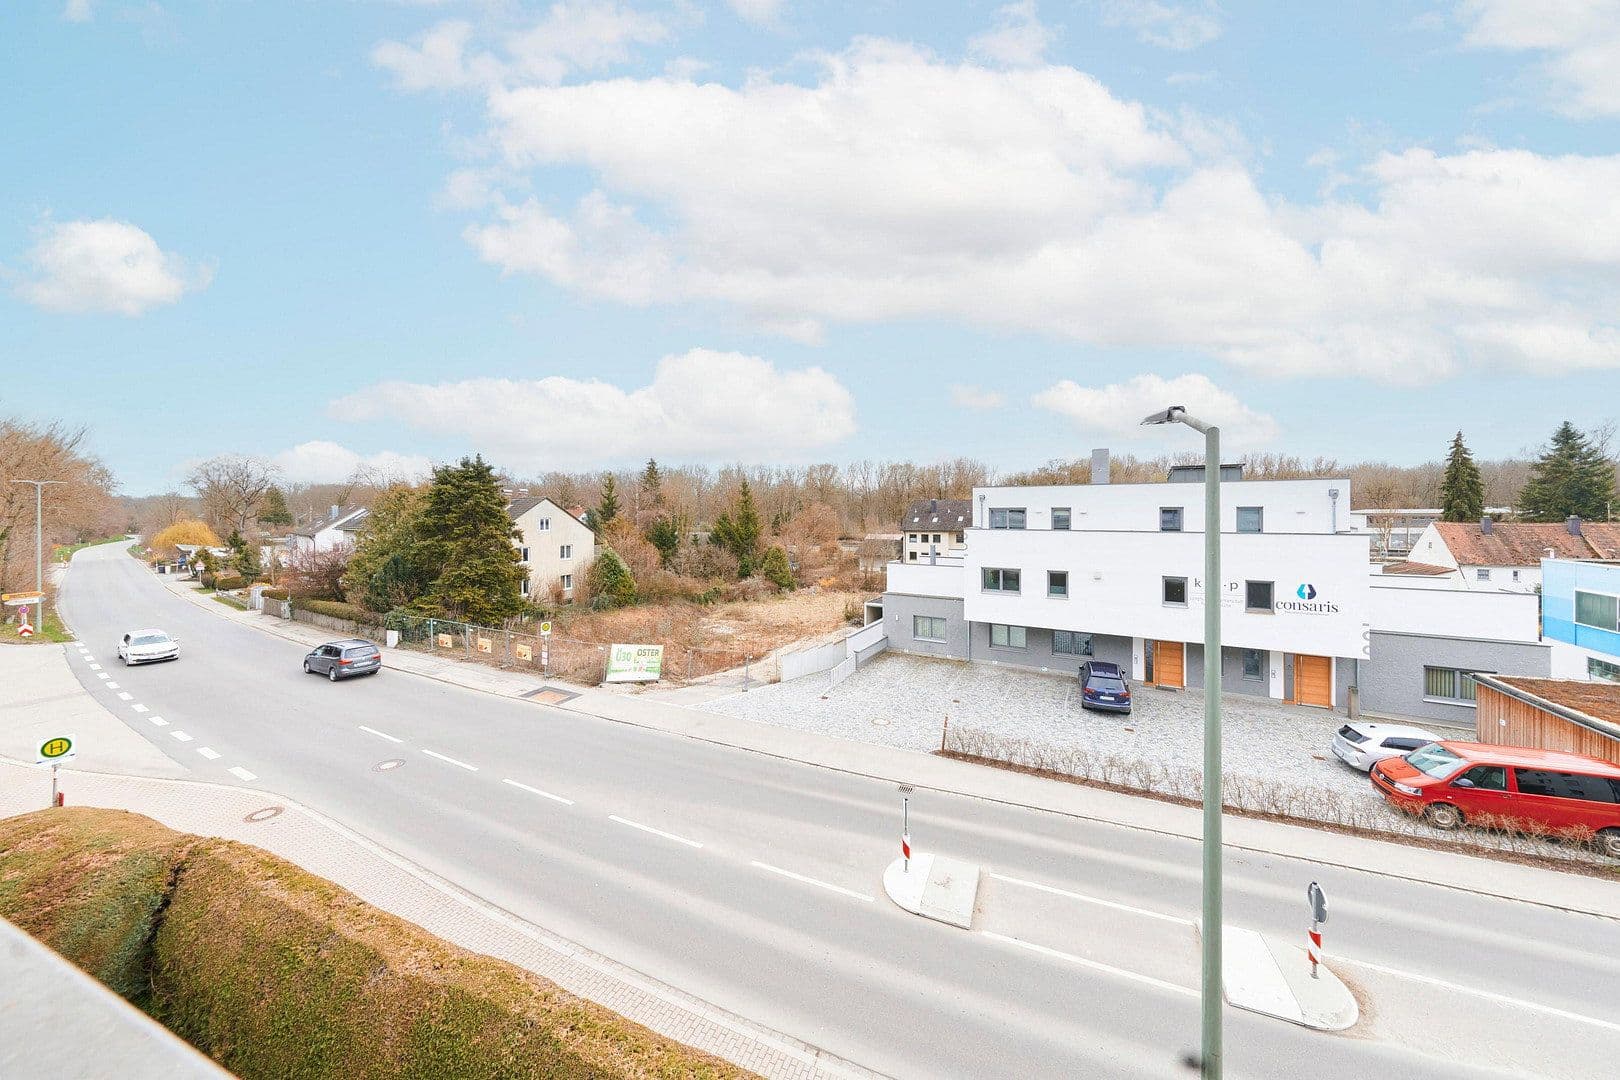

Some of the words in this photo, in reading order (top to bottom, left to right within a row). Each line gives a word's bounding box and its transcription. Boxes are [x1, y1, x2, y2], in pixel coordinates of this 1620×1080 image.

[1275, 600, 1339, 613] consaris
[637, 648, 660, 657] OSTER
[50, 741, 63, 754] H
